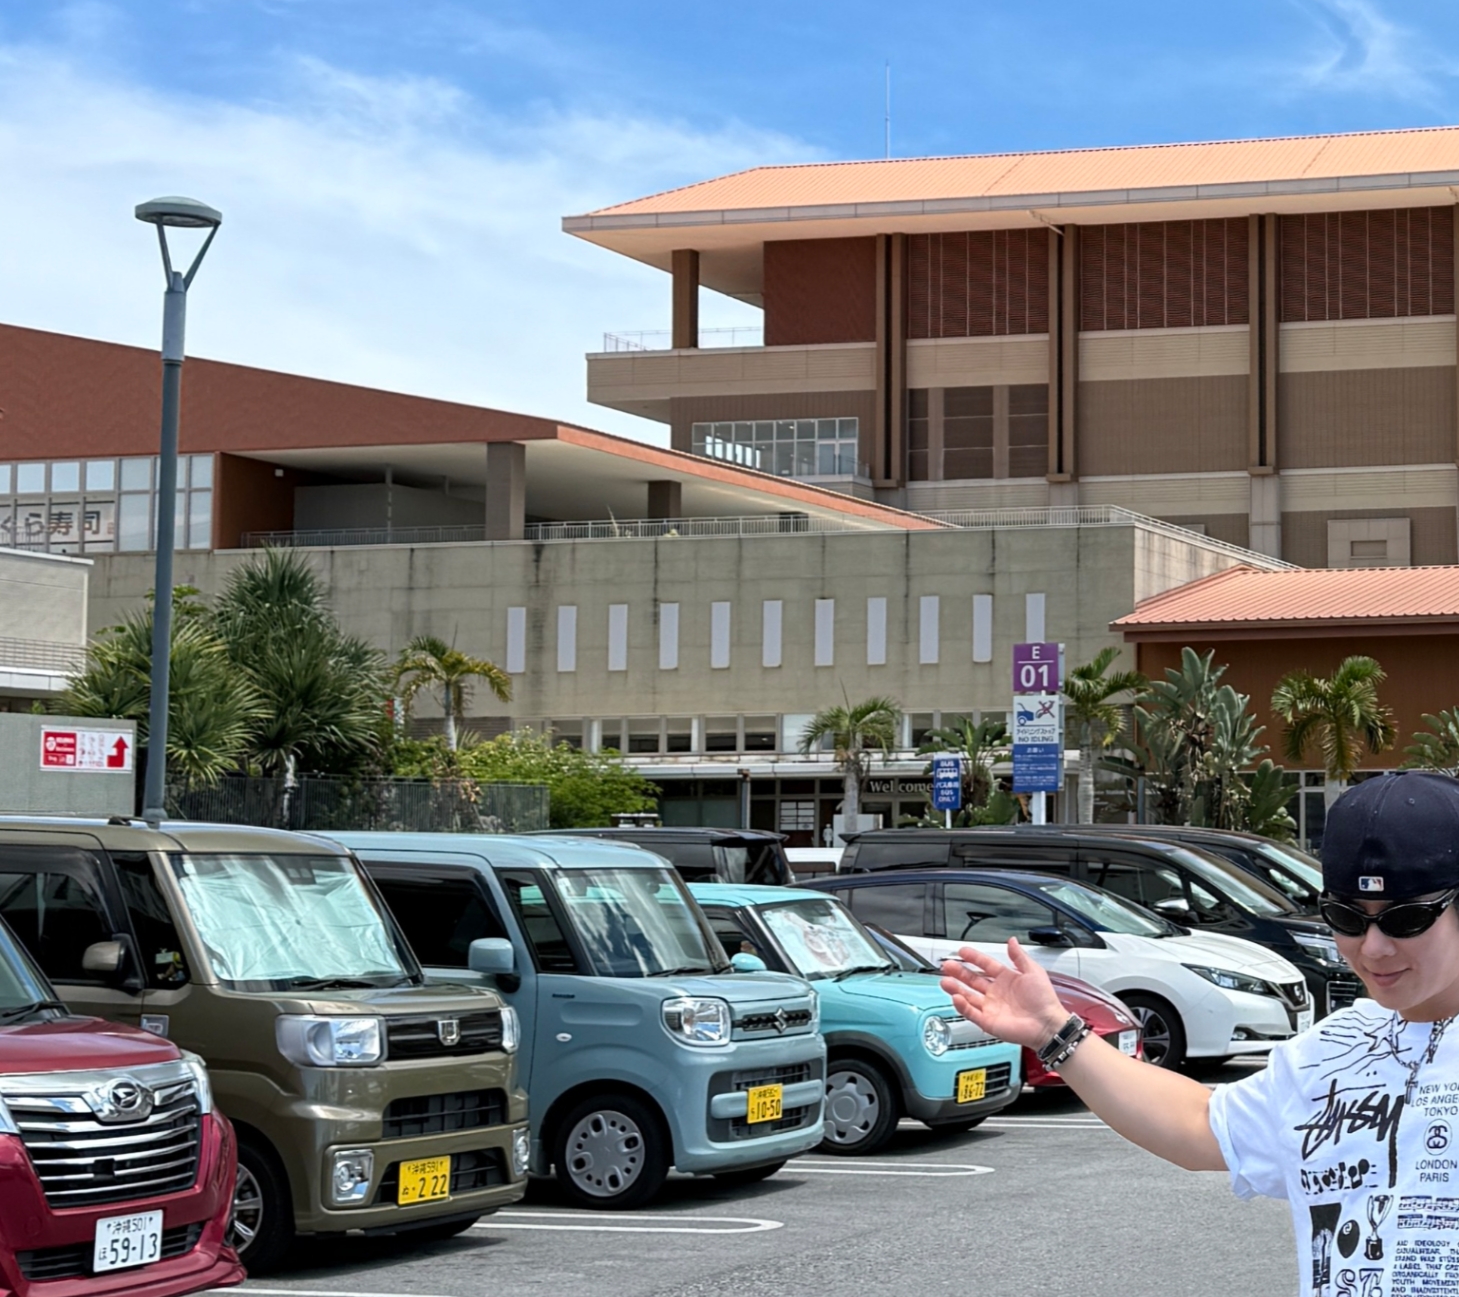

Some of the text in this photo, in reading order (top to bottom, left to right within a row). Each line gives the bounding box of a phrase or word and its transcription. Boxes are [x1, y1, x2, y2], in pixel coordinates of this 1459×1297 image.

[1032, 646, 1040, 659] E
[1021, 665, 1048, 687] 01
[1419, 1084, 1439, 1094] NEW
[1410, 1097, 1428, 1107] LOS
[1424, 1105, 1458, 1116] TOKYO
[1415, 1159, 1458, 1170] LONDON
[1420, 1172, 1450, 1182] PARIS
[109, 1233, 158, 1265] 59-13
